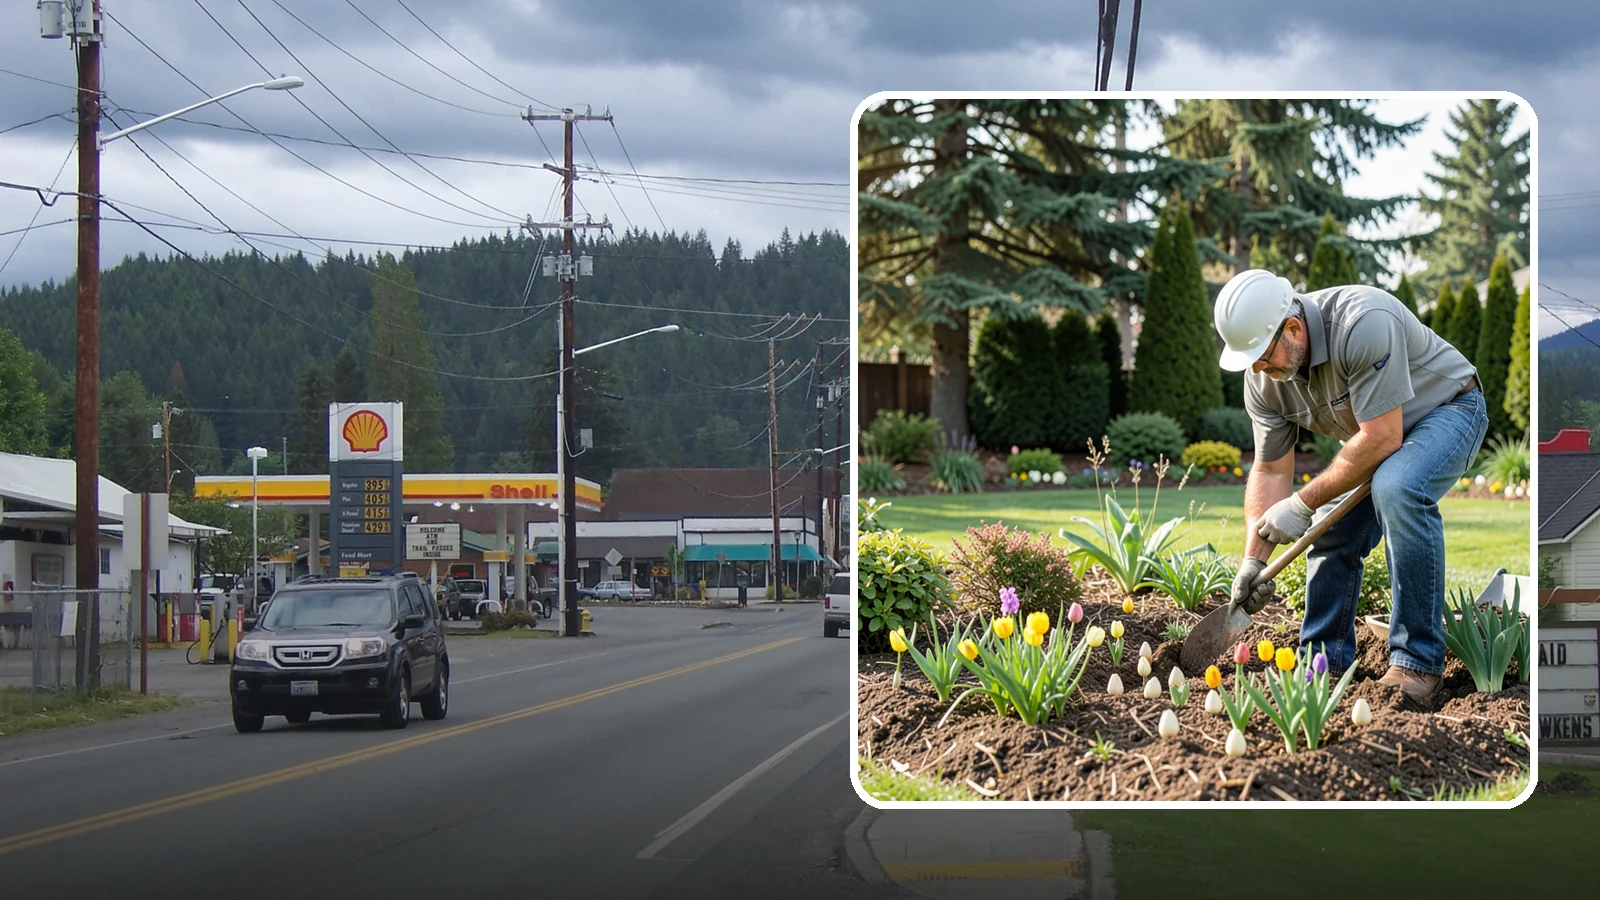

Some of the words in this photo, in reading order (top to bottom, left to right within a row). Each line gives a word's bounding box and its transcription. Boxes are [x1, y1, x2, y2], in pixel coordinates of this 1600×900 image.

[365, 480, 383, 490] 395
[490, 484, 547, 499] Shell
[365, 494, 383, 504] 405
[365, 508, 383, 518] 415
[365, 522, 383, 532] 429
